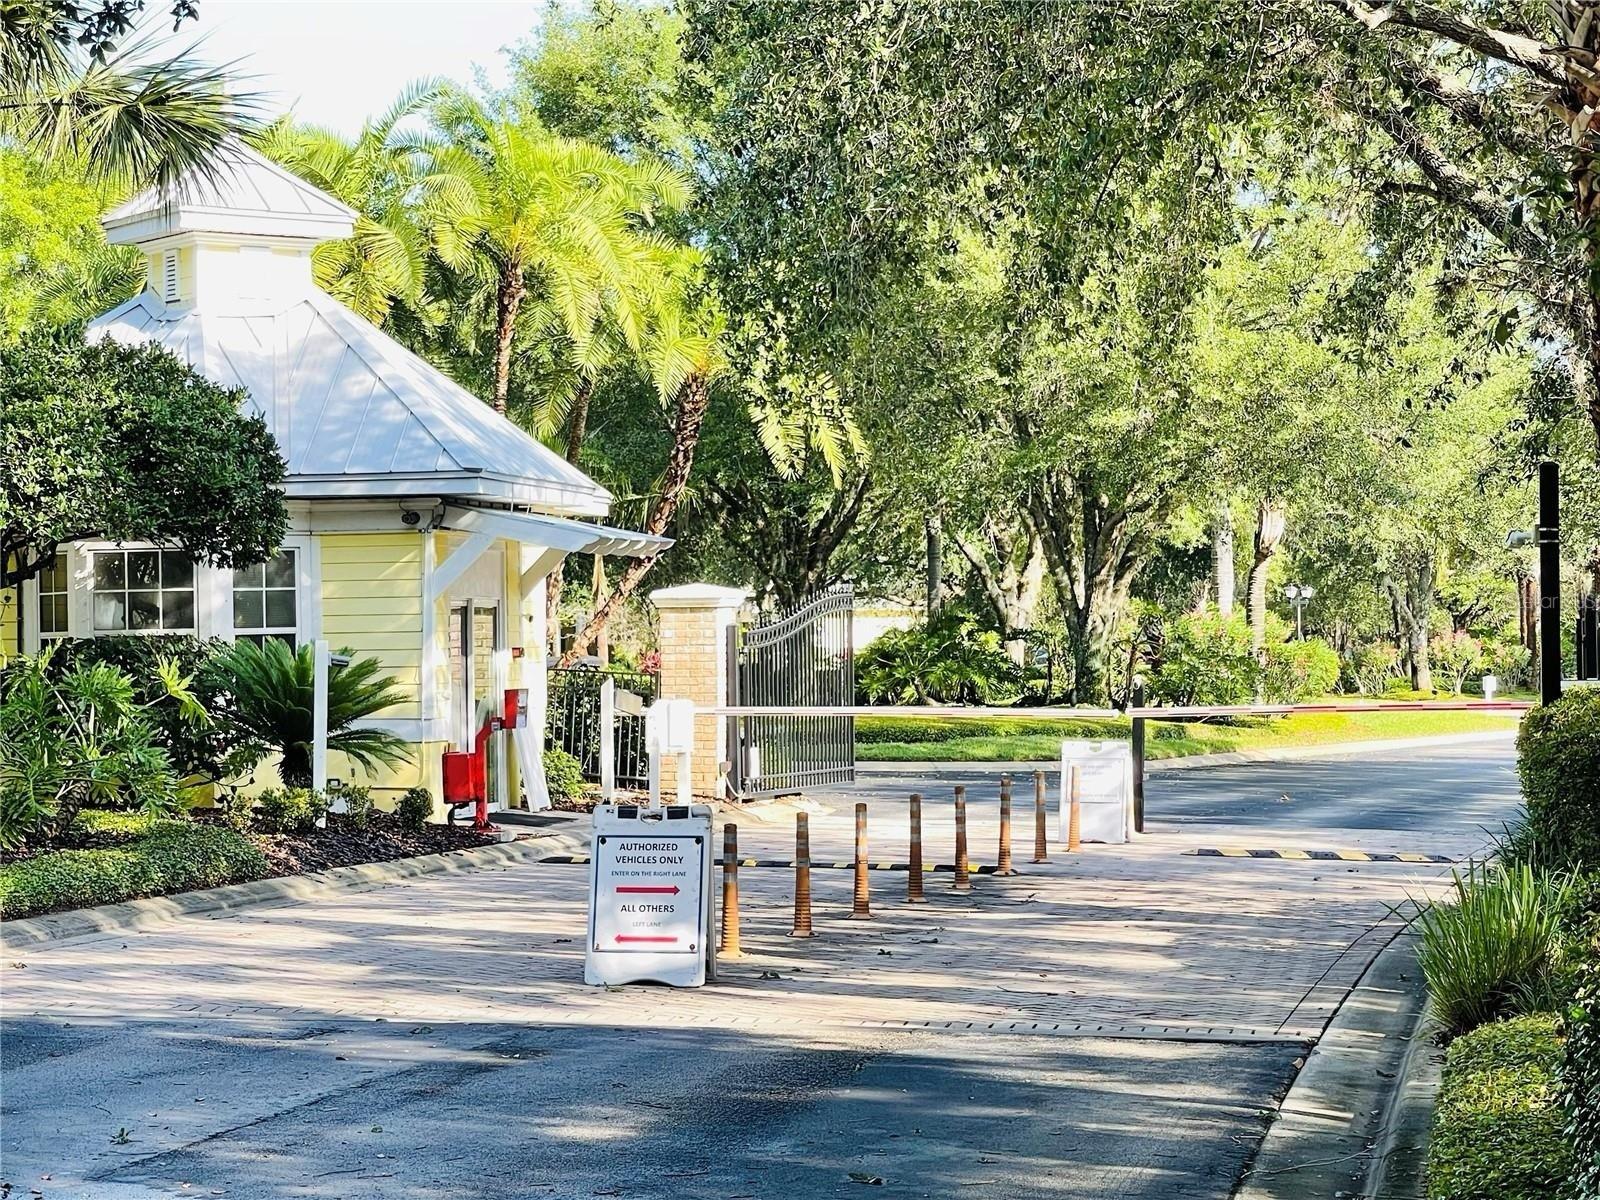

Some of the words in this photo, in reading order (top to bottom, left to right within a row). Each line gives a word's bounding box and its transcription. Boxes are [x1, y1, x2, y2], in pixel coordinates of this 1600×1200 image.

[619, 843, 678, 851] AUTHORIZED
[615, 855, 657, 864] VEHICLES
[659, 855, 684, 864] ONLY
[620, 904, 636, 913] ALL
[638, 904, 675, 913] OTHERS
